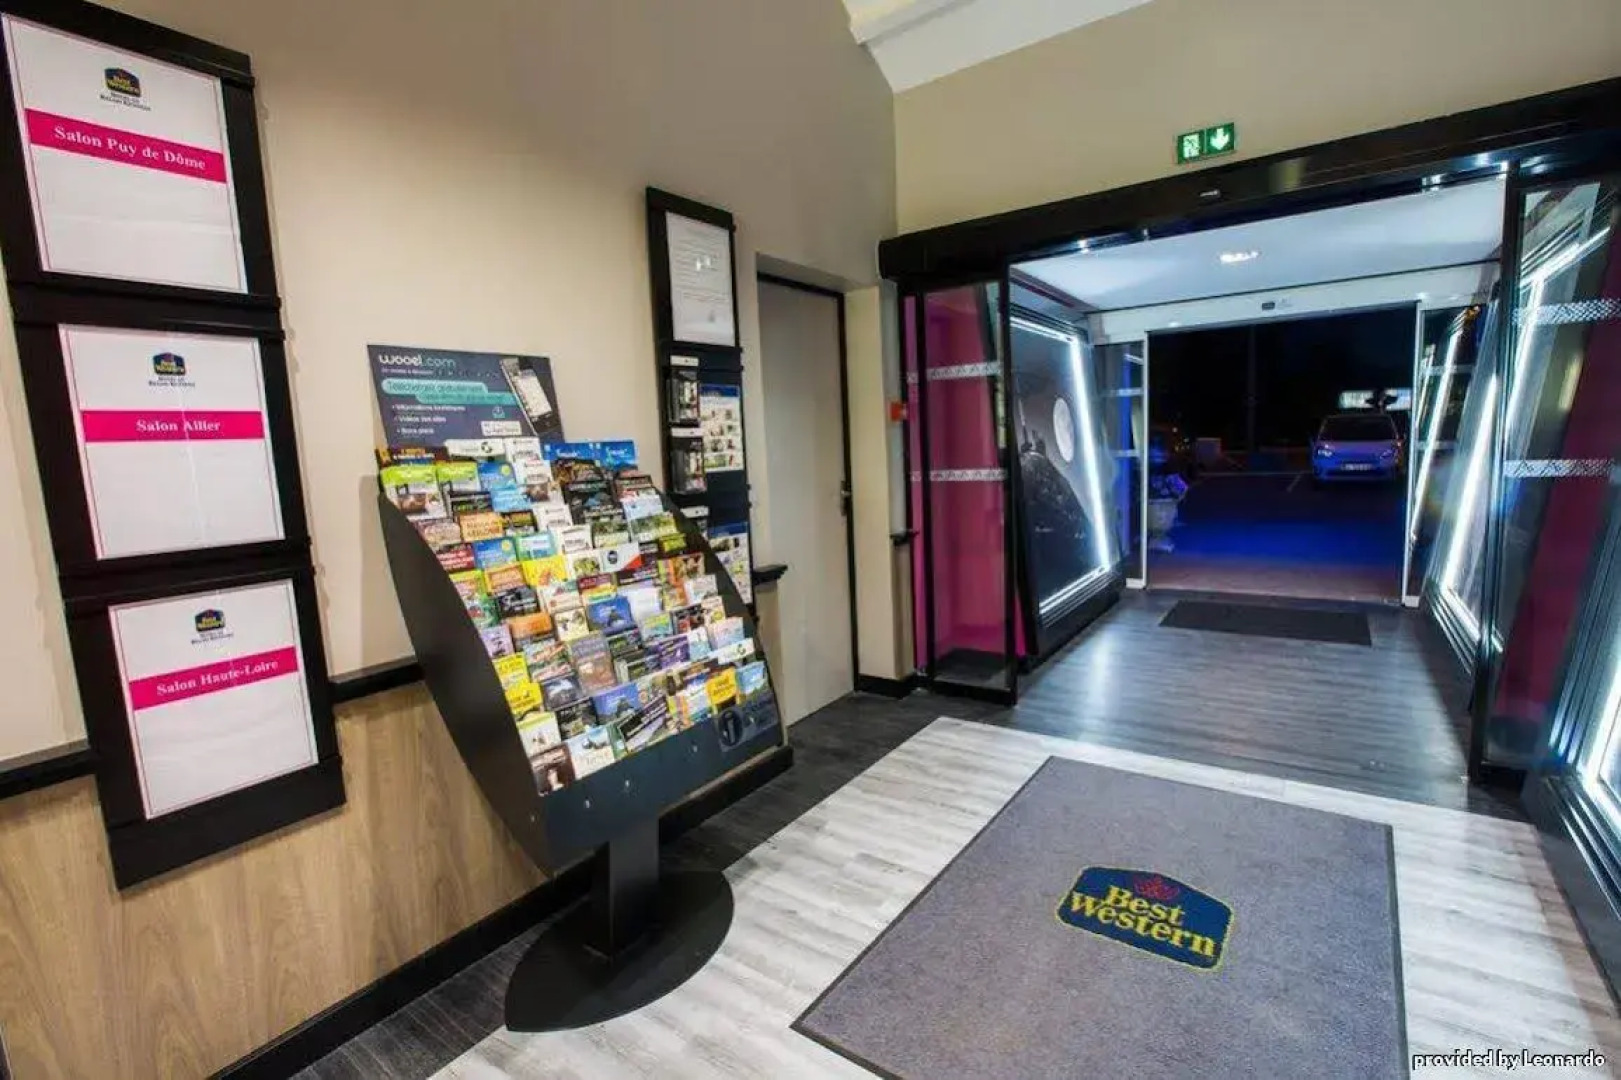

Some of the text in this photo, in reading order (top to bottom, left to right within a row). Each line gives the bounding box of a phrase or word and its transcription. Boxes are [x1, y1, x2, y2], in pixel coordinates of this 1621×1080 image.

[54, 124, 206, 169] Salon Puy de Dôme
[136, 419, 221, 432] Salon Allier
[156, 660, 279, 696] Salon Haute-Loire
[1071, 891, 1216, 957] Western
[1108, 885, 1185, 926] Best
